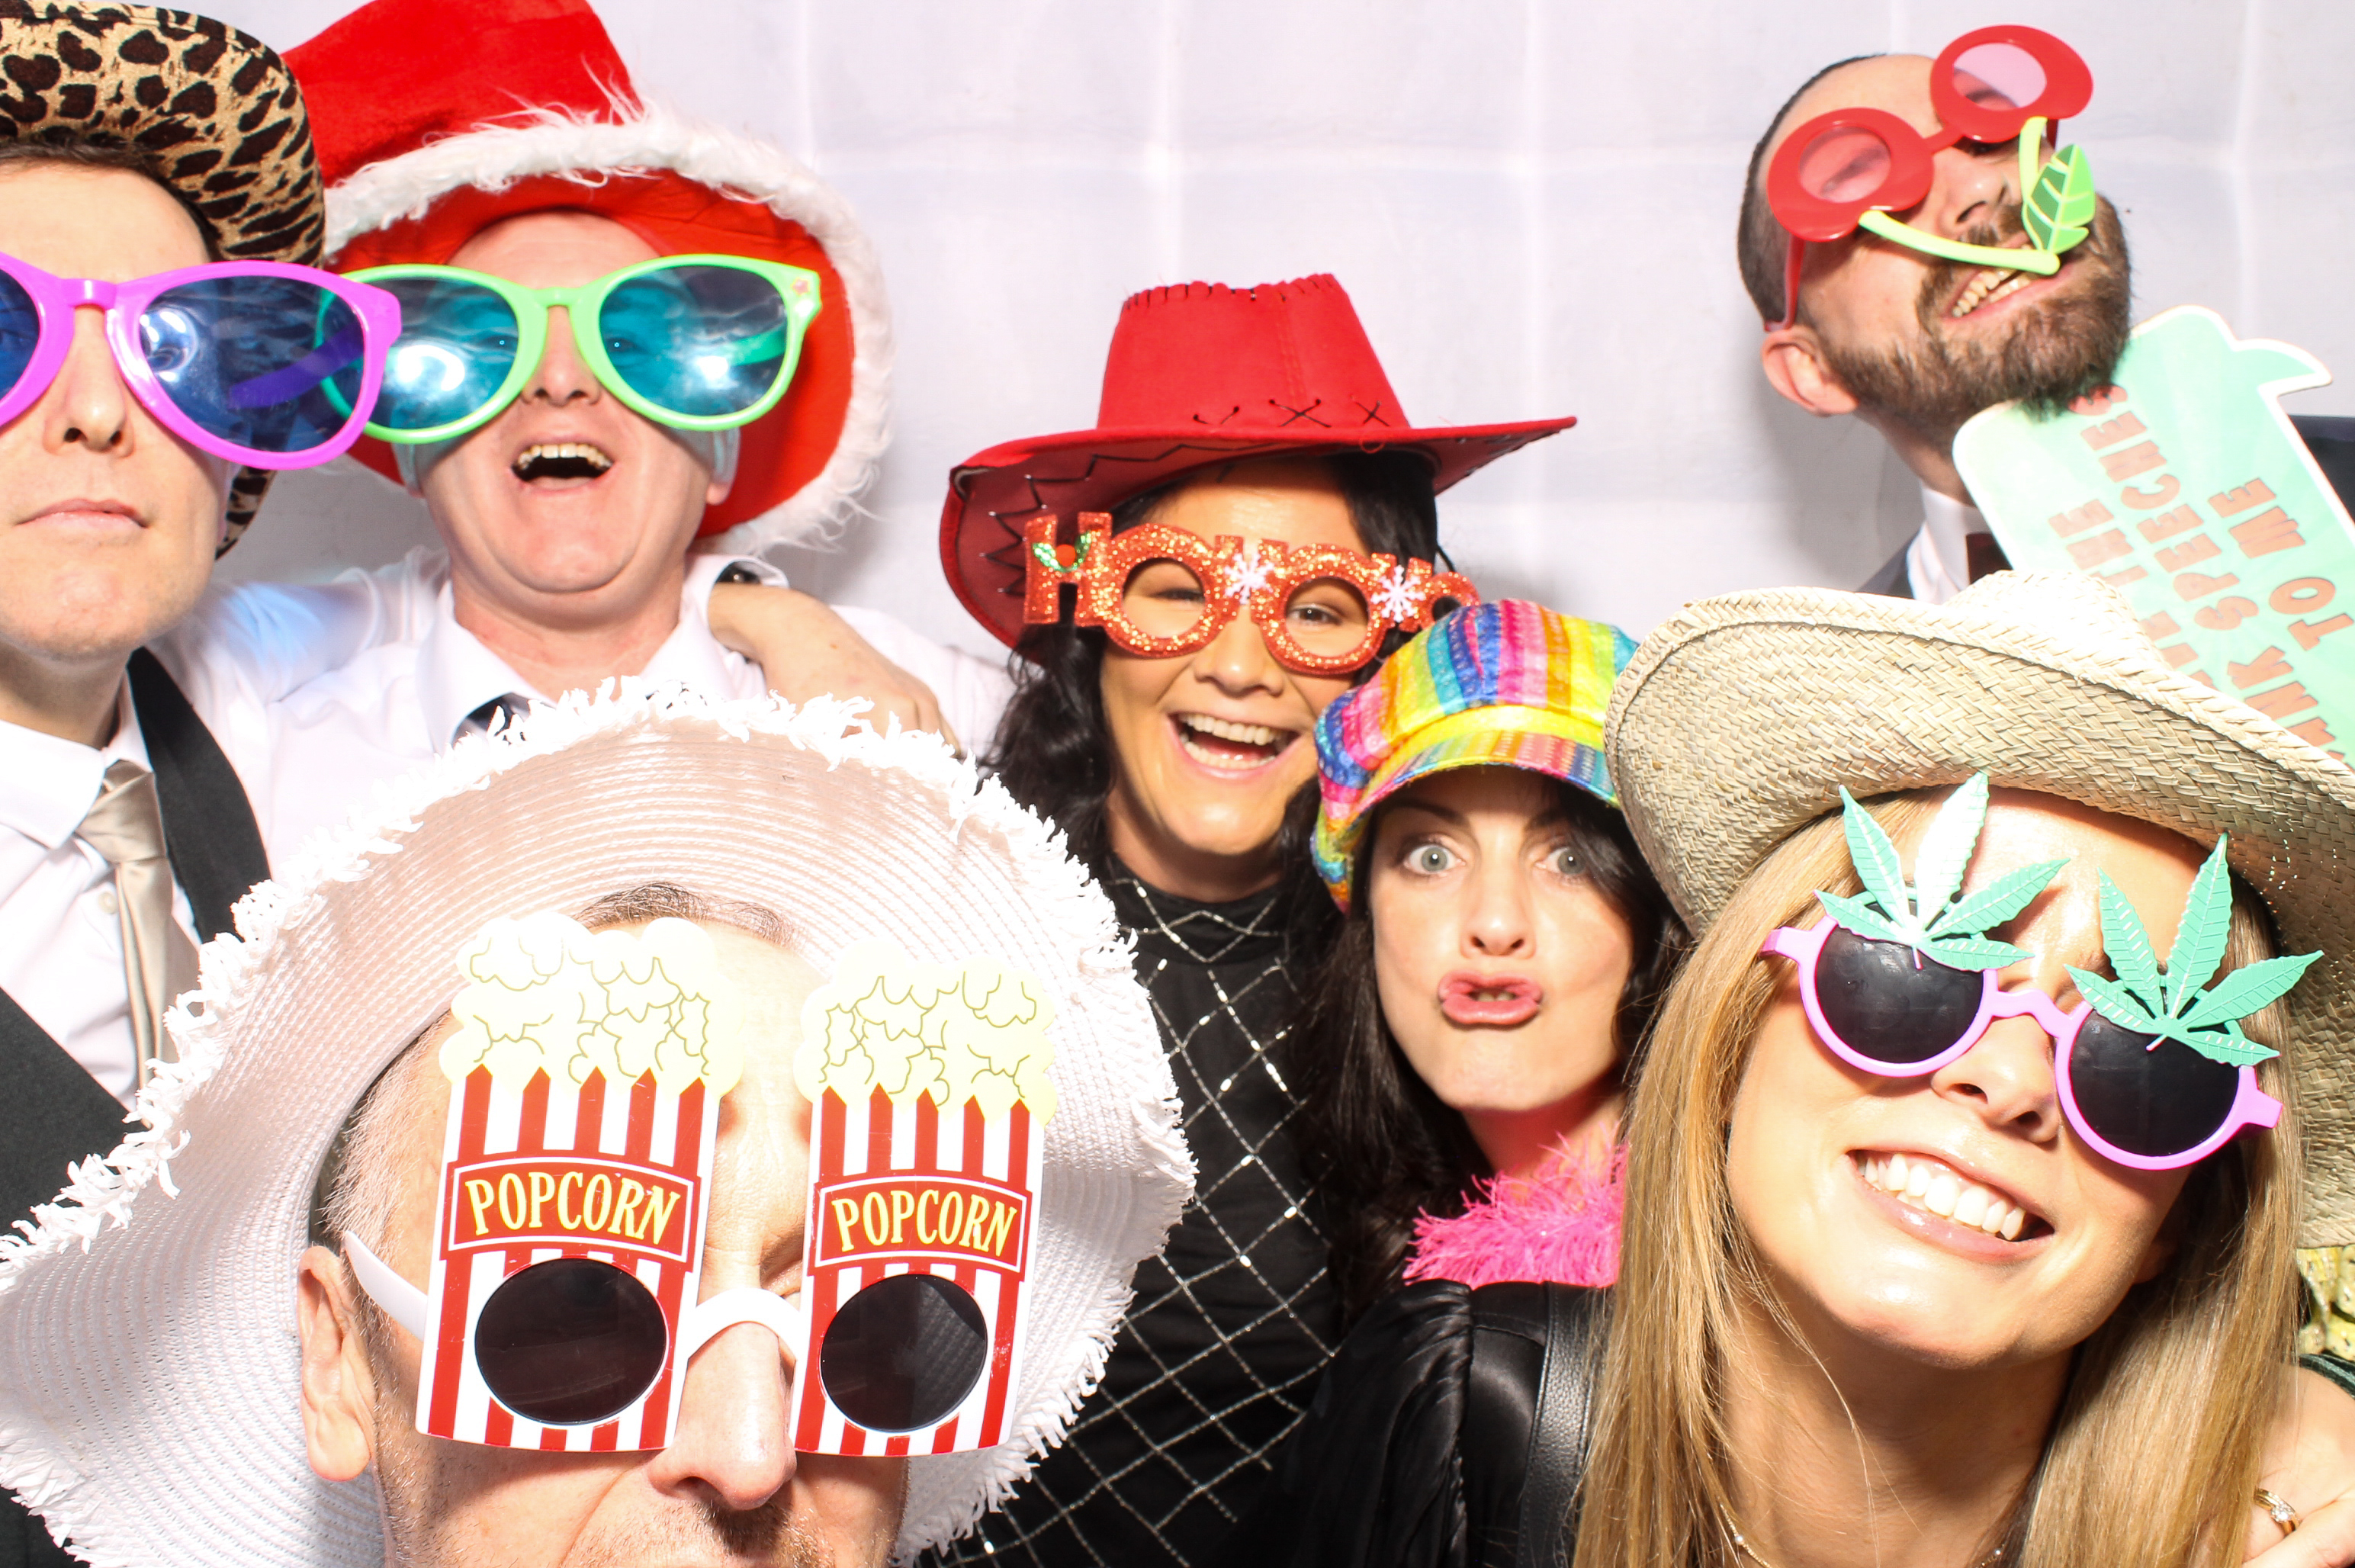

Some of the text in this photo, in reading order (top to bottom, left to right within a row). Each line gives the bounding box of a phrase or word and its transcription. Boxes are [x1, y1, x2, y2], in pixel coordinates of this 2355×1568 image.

[2048, 500, 2148, 587] THE
[2068, 384, 2259, 630] SPEECHES
[2209, 478, 2354, 650] TO ME
[466, 1171, 681, 1245] POPCORN
[832, 1190, 1017, 1257] POPCORN
